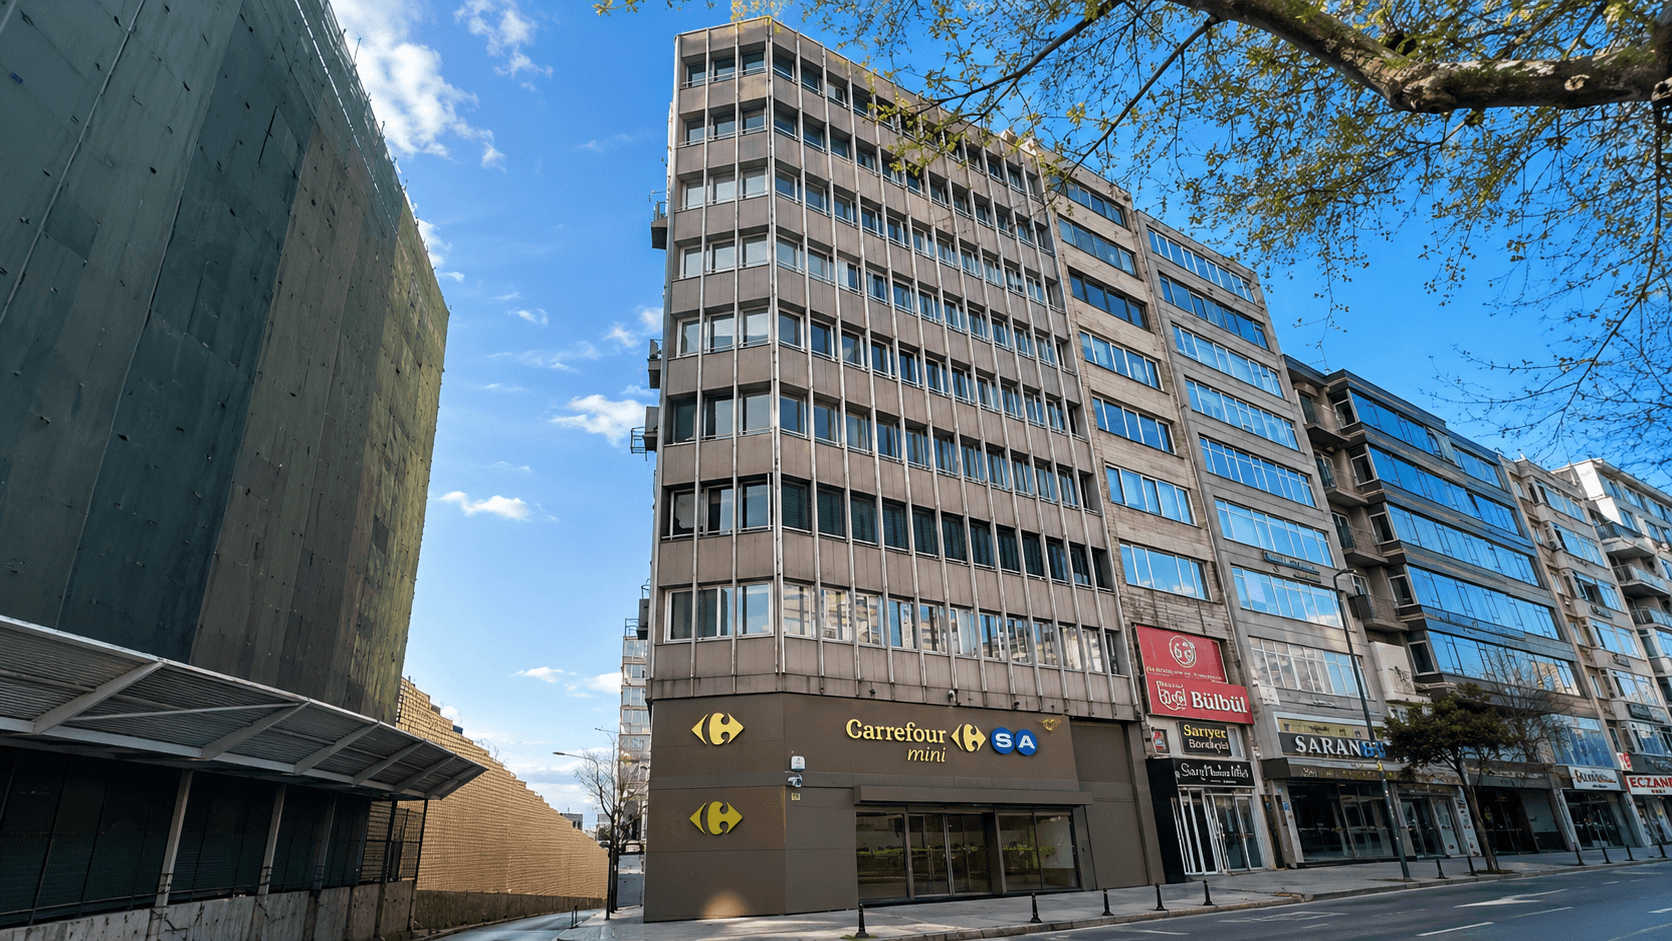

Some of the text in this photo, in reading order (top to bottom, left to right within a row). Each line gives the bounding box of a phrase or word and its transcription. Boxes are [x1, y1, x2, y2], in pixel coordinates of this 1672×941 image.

[1190, 691, 1248, 713] Bülbül
[845, 718, 947, 744] Carrefour
[907, 746, 946, 763] mini
